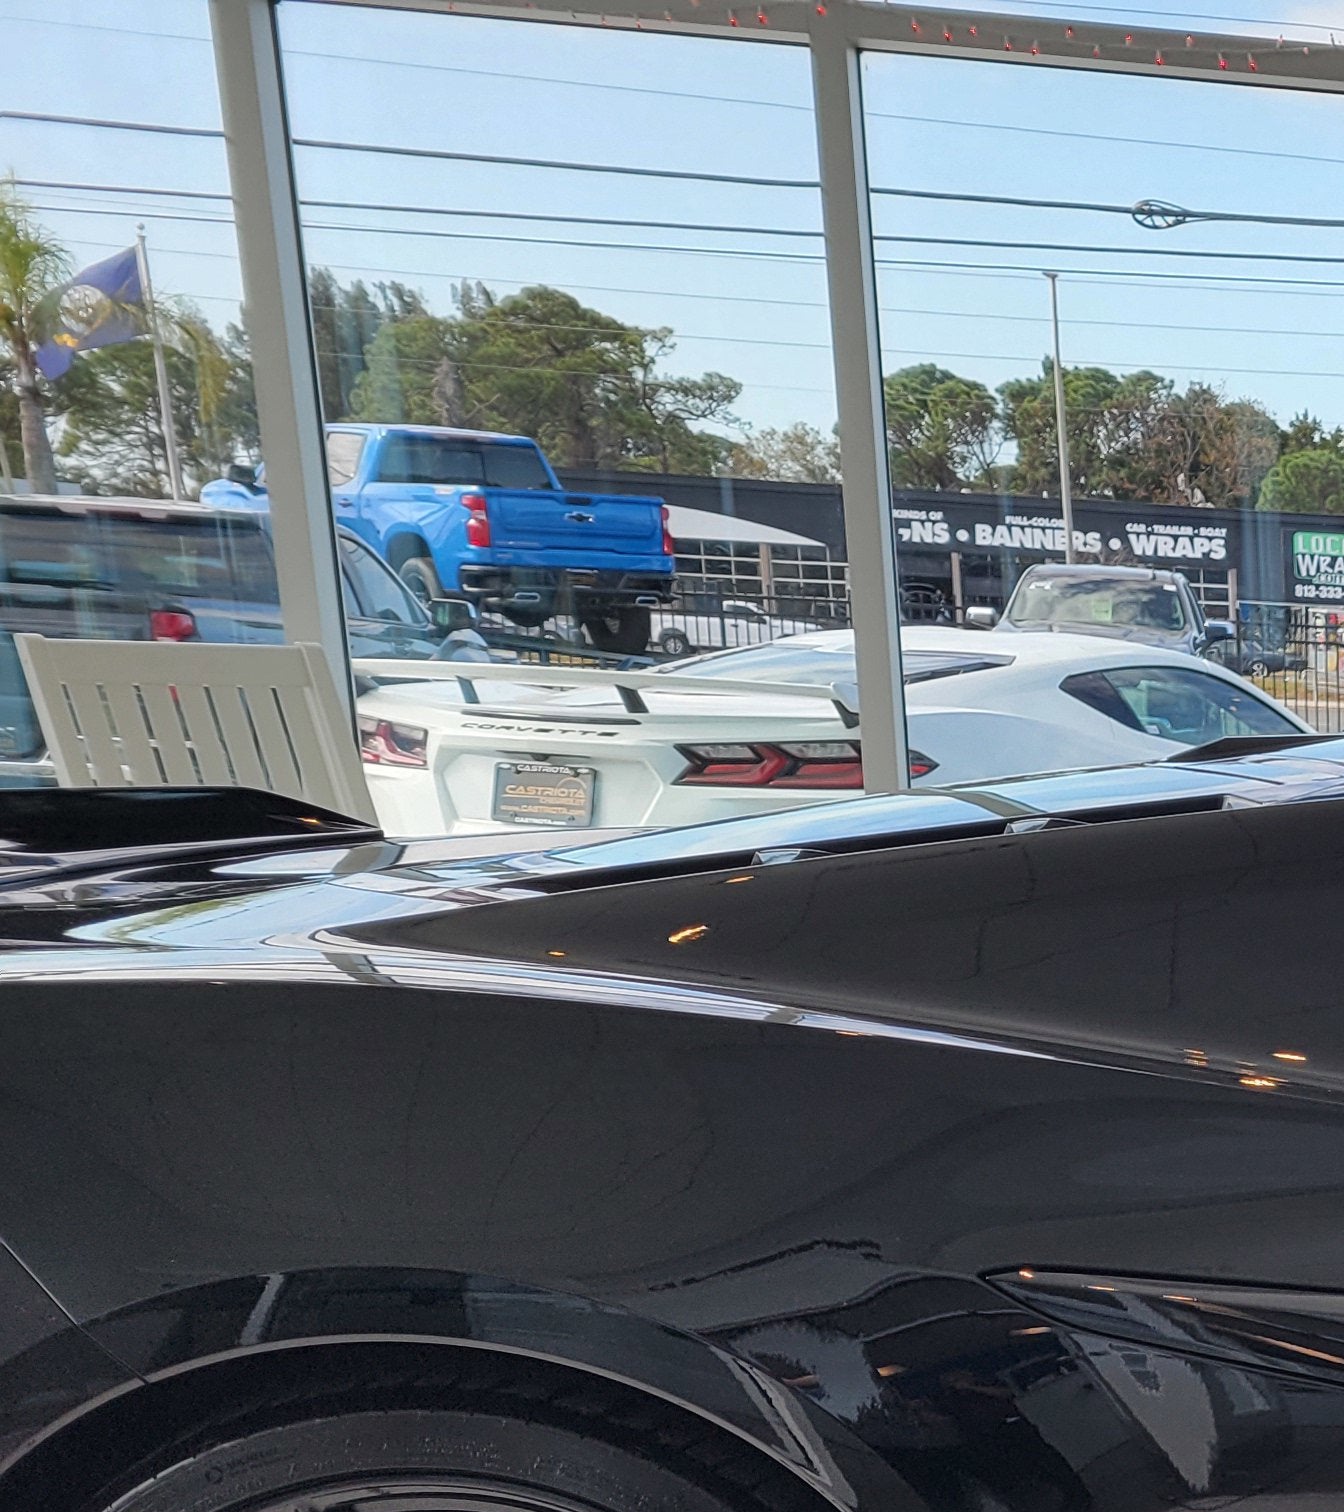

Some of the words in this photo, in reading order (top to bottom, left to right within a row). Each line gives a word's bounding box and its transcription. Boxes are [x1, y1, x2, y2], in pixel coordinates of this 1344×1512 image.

[1125, 523, 1147, 533] CAR
[1152, 524, 1193, 535] TRAILER
[974, 523, 1102, 552] BANNERS
[1127, 533, 1227, 560] WRAPS
[461, 722, 620, 737] CORVETTE
[517, 764, 570, 774] CASTRIOTA
[505, 784, 585, 798] CASTRIOTA
